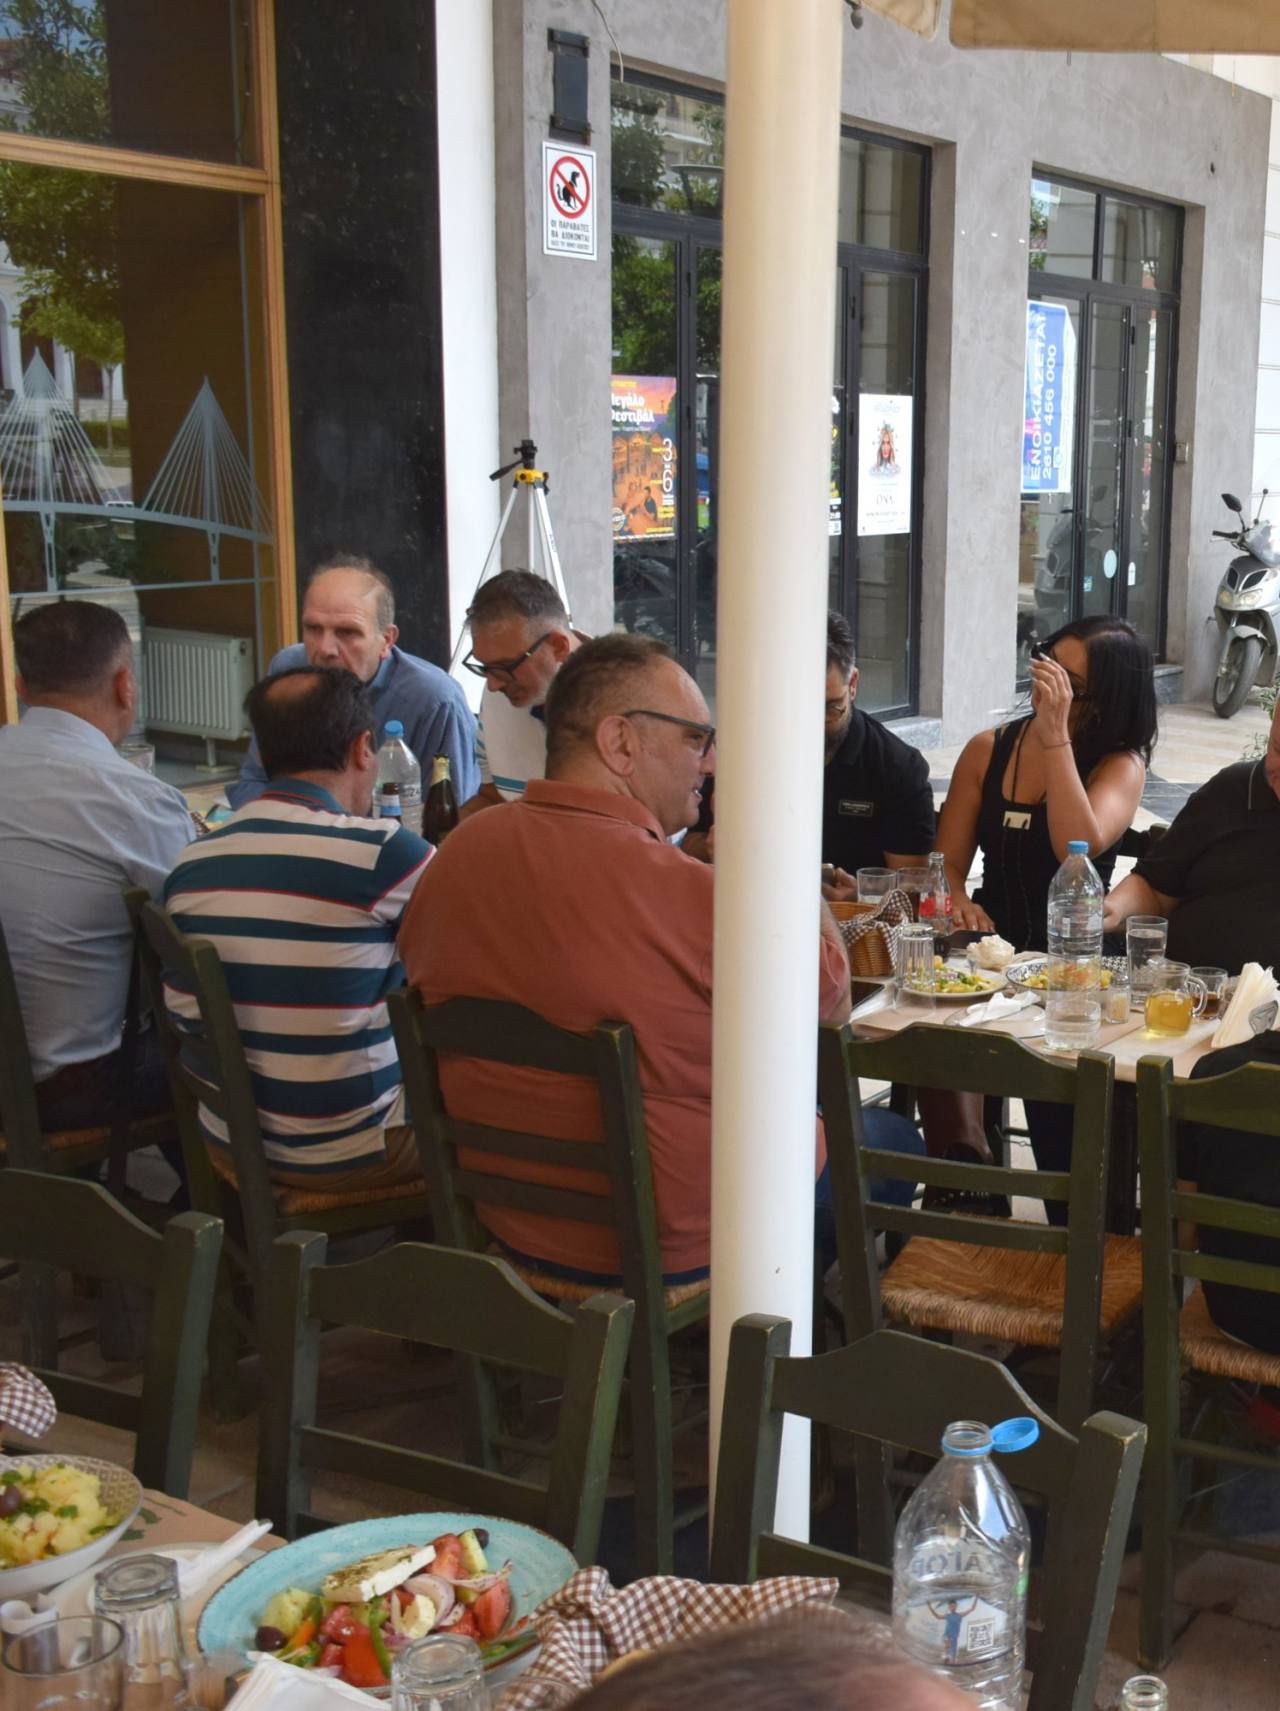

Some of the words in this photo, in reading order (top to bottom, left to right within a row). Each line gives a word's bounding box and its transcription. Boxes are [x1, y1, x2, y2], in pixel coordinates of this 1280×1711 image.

[1046, 343, 1057, 382] 000
[1030, 312, 1047, 481] ΕΝΟΙΚΙΑΖΕΤΑΙ
[1044, 388, 1055, 427] 456
[1043, 432, 1053, 480] 2610
